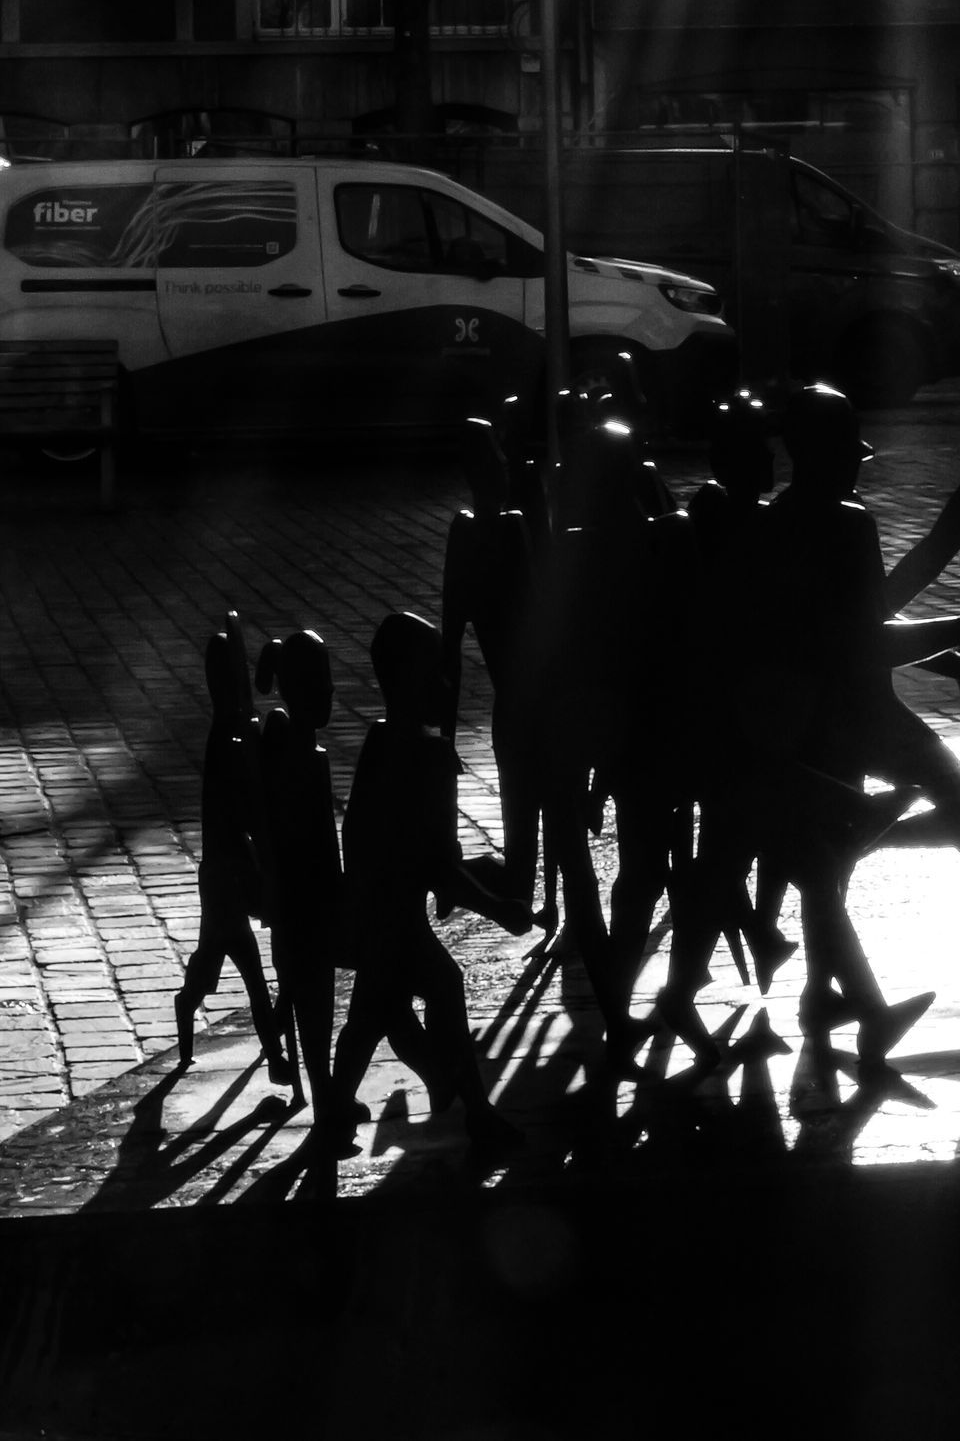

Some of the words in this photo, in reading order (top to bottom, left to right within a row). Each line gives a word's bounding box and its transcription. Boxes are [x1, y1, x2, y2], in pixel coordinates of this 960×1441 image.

[33, 202, 98, 223] fiber
[164, 280, 201, 294] Think
[205, 279, 262, 296] possible
